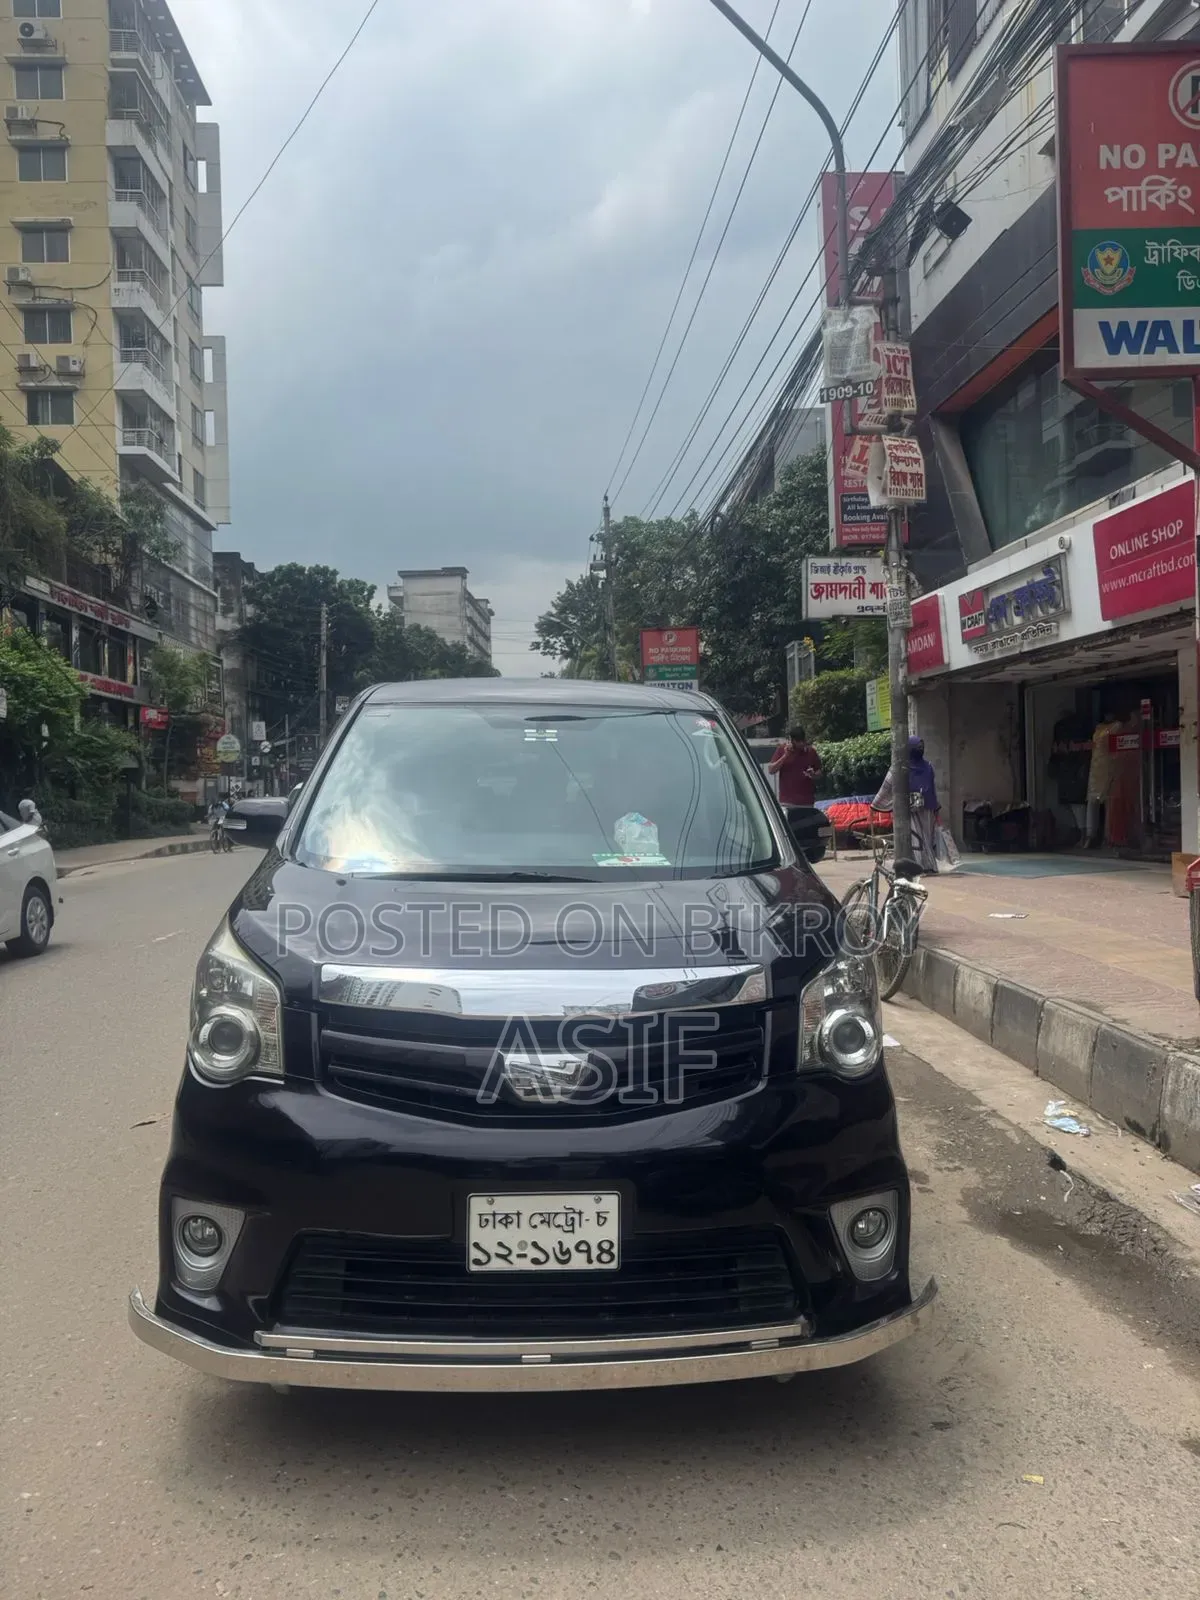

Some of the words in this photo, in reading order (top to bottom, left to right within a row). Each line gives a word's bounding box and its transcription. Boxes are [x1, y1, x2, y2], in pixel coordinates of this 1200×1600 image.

[1099, 143, 1146, 170] NO
[1103, 174, 1195, 215] পার্কিং
[1097, 319, 1200, 356] WAL
[843, 512, 870, 522] Booking
[1109, 532, 1150, 560] ONLINE
[1151, 519, 1184, 545] SHOP
[810, 575, 866, 603] জামদানী
[477, 1209, 523, 1229] ঢাকা
[471, 1239, 616, 1266] ১২-১৬৭৪
